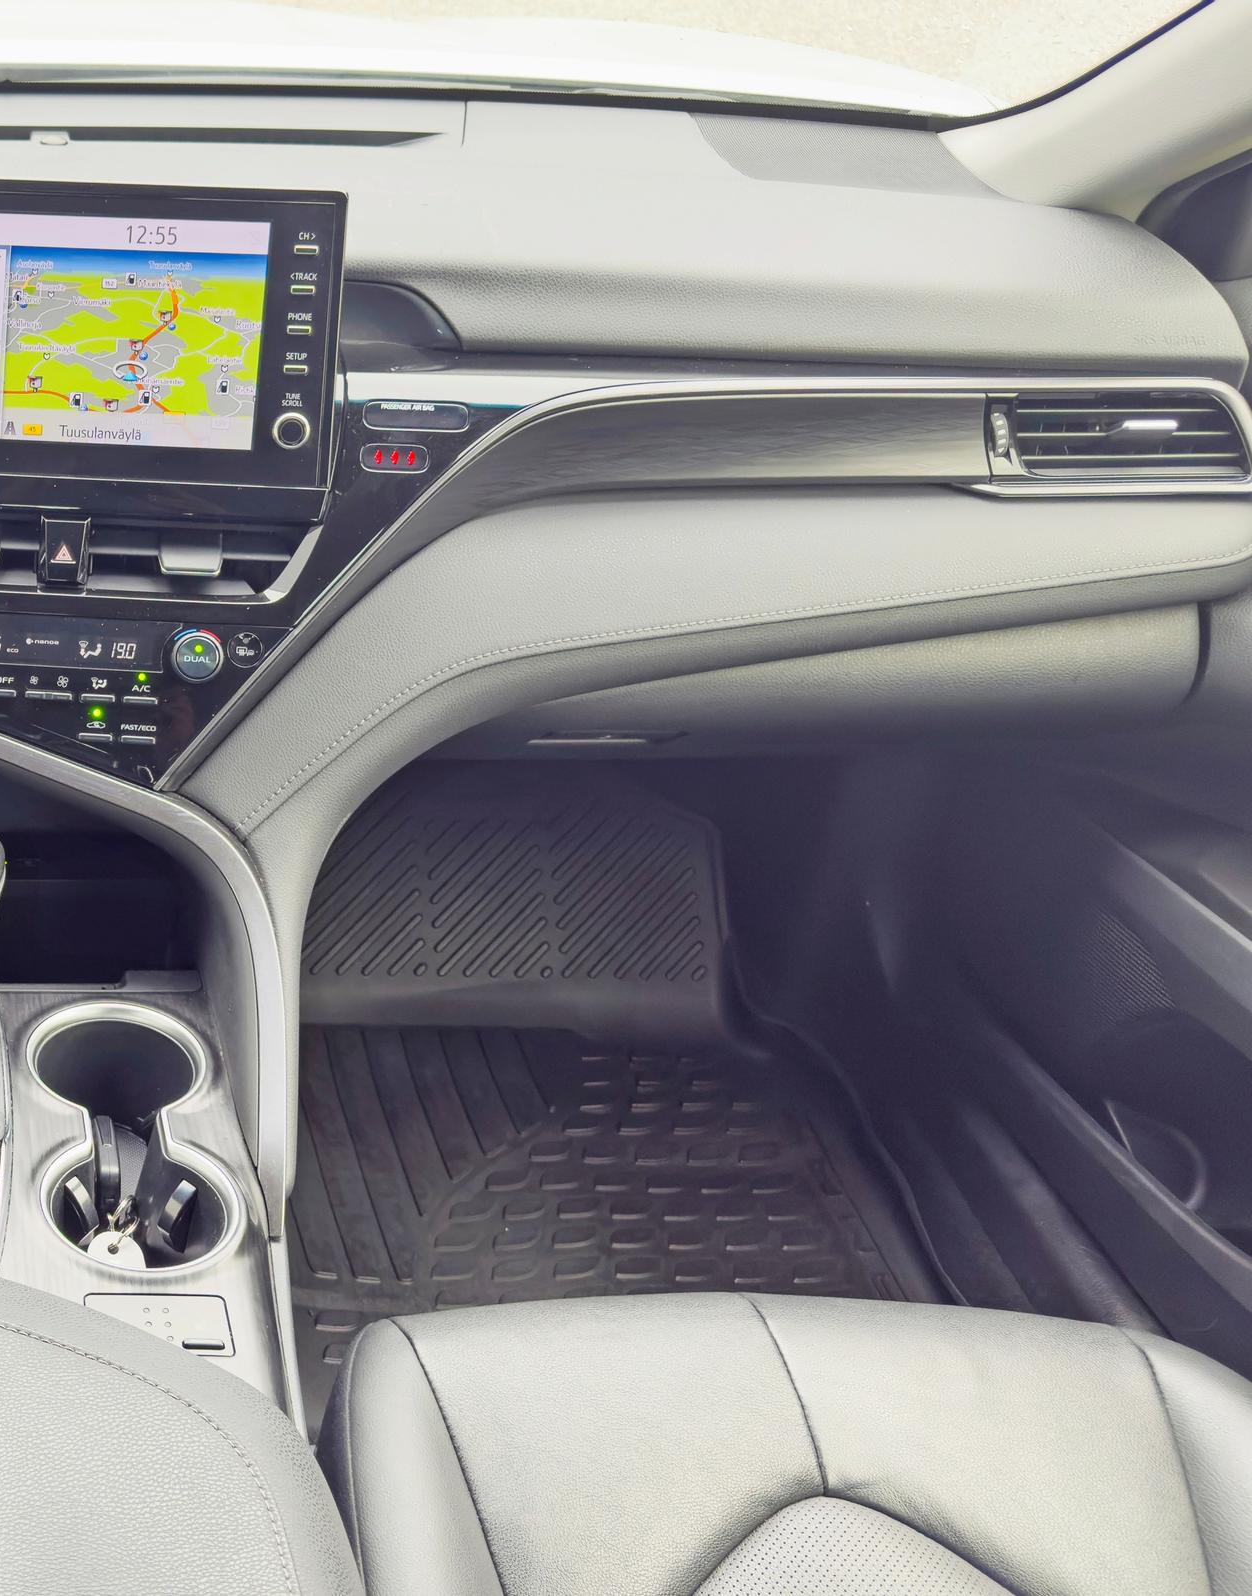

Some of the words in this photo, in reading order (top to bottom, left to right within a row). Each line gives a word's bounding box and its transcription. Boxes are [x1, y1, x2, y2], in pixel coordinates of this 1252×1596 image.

[127, 225, 177, 245] 12:55
[288, 313, 312, 321] PHONE
[286, 352, 307, 360] SETUP
[281, 399, 303, 407] SCROLL
[380, 403, 412, 411] PASSENGER
[60, 425, 142, 441] Tuusulanväylä
[183, 656, 211, 664] DUAL
[120, 723, 157, 732] FAST/ECO
